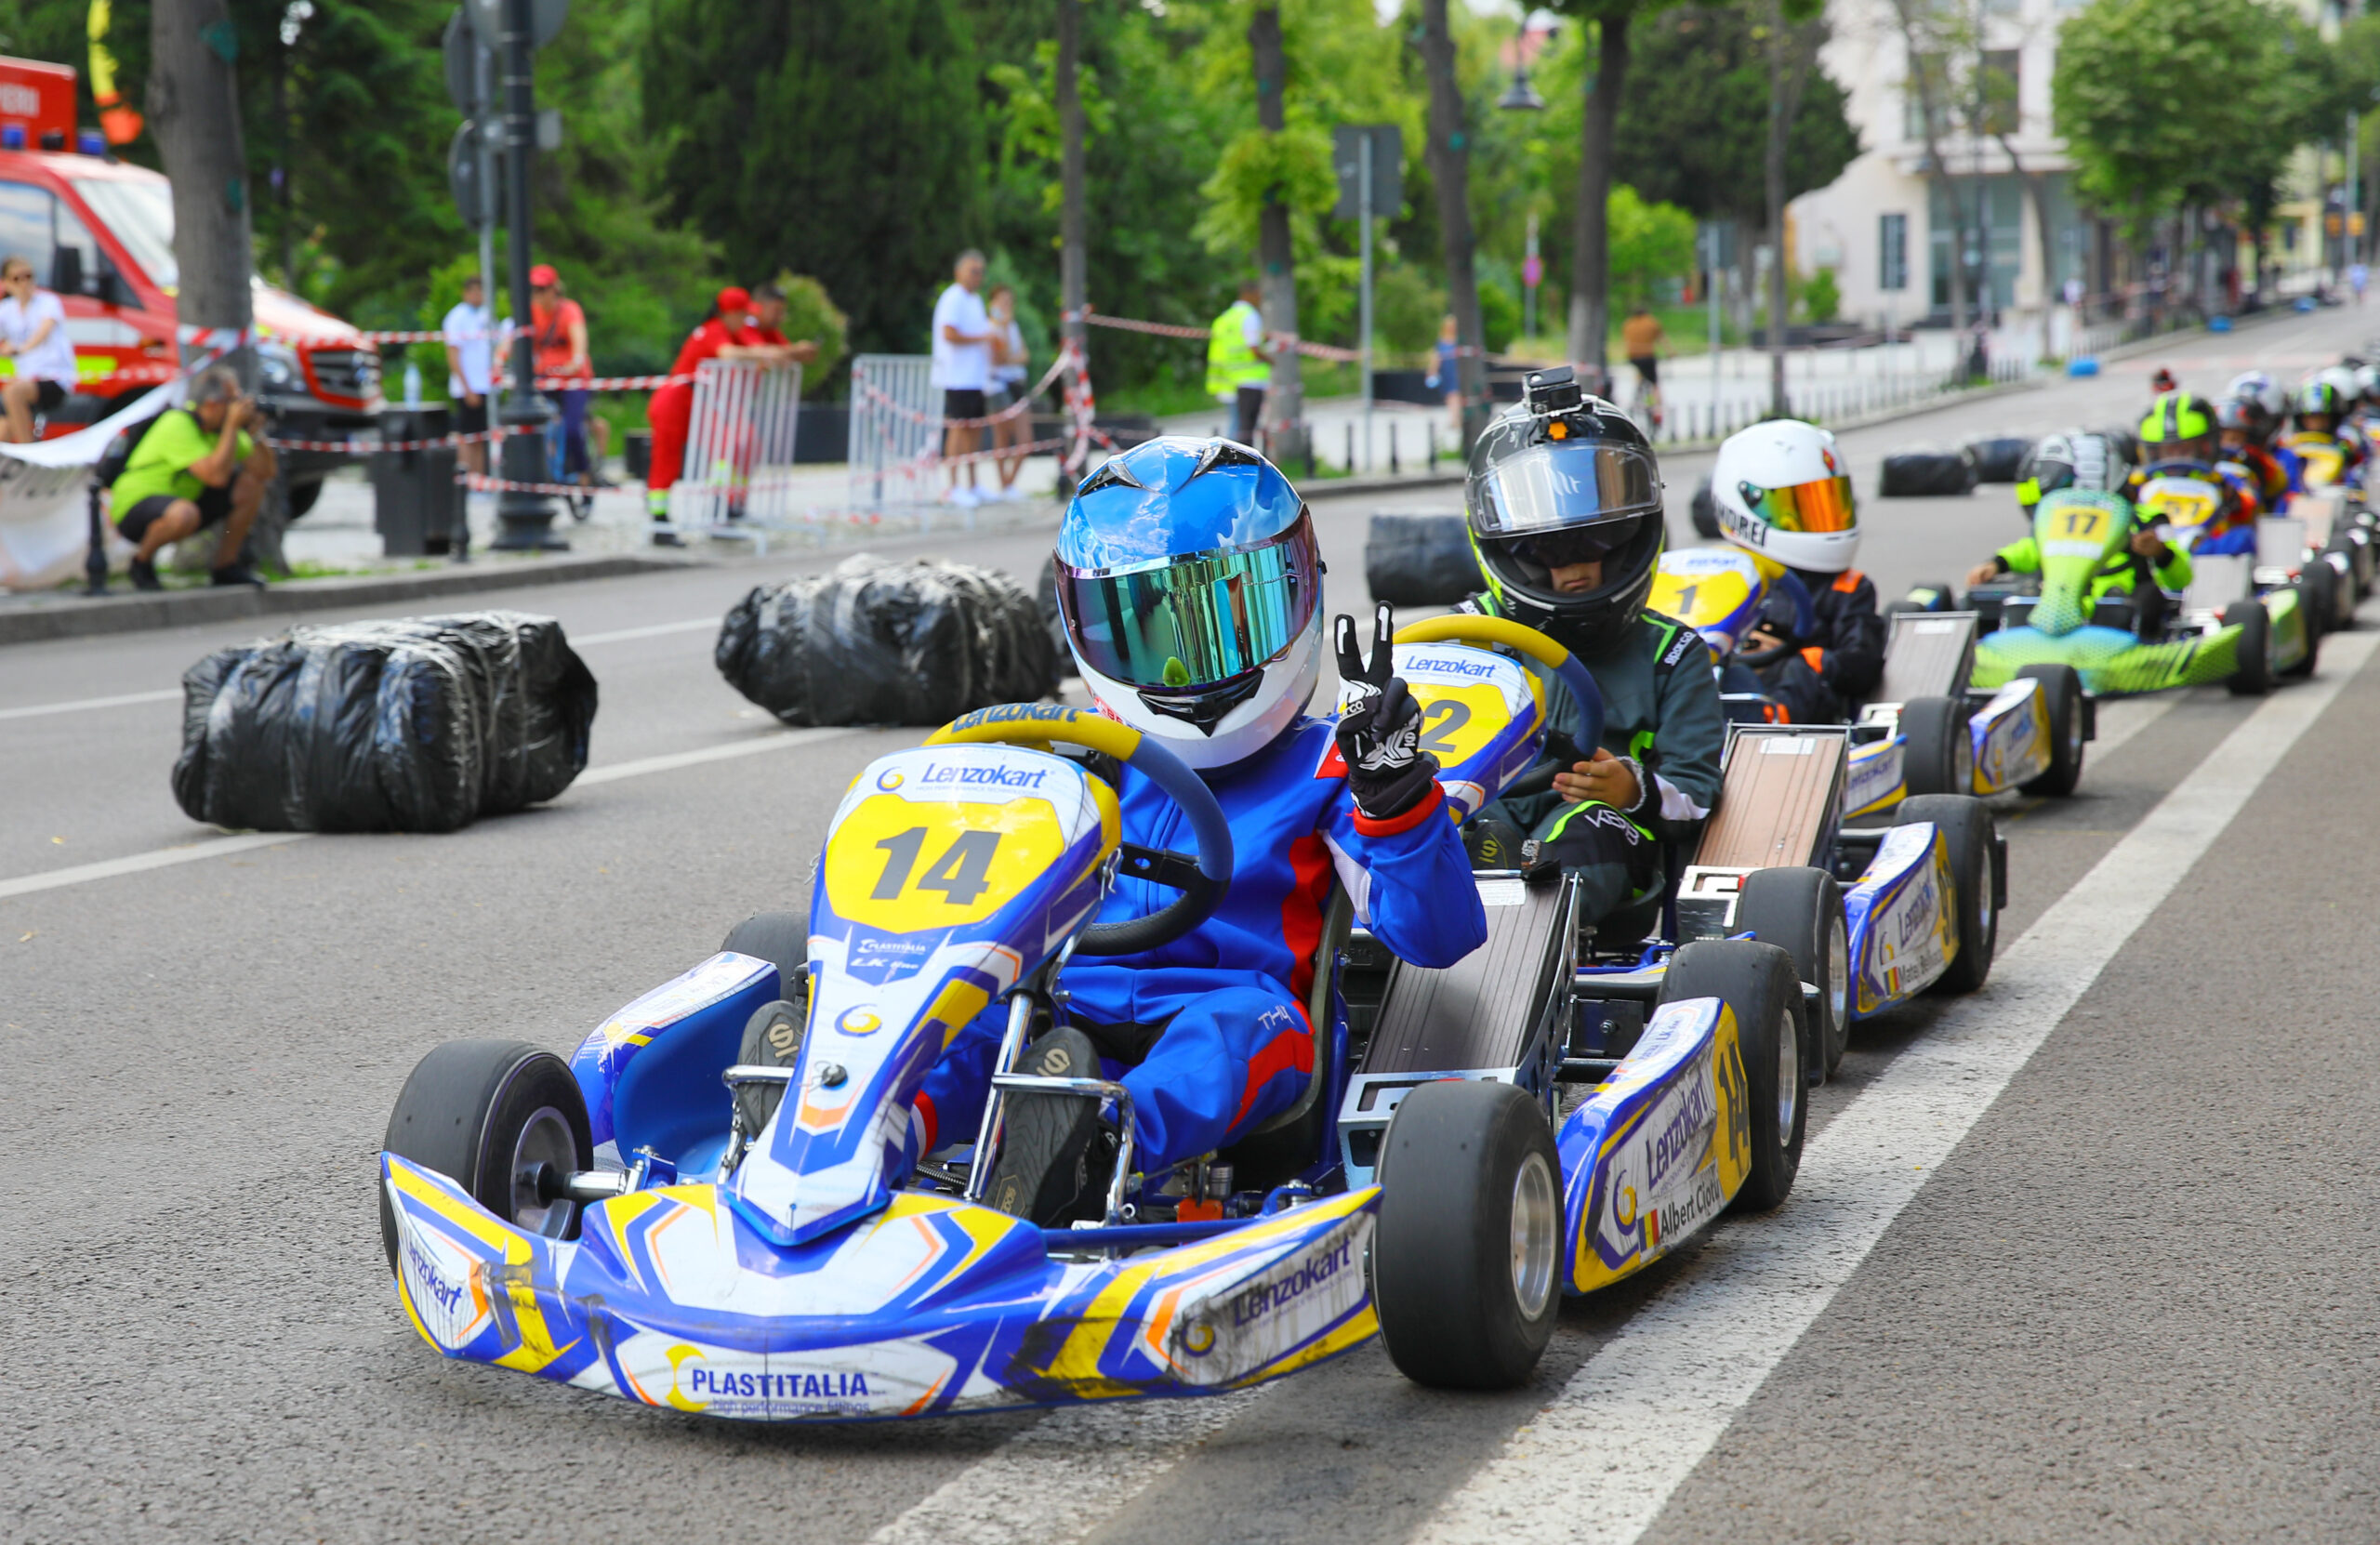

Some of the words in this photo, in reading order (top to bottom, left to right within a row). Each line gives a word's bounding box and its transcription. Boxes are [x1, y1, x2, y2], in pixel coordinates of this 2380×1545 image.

[2064, 513, 2098, 535] 17
[1675, 585, 1699, 615] 1
[1663, 630, 1699, 667] sparco
[1405, 655, 1498, 679] Lenzokart
[950, 702, 1079, 733] Lenzokart
[920, 762, 1048, 789] Lenzokart
[869, 826, 1003, 906] 14
[850, 957, 889, 967] LK
[1717, 1041, 1749, 1162] 14
[1646, 1067, 1708, 1192] Lenzokart
[1659, 1197, 1695, 1239] Albert
[403, 1227, 463, 1315] Lenzokart
[1235, 1236, 1351, 1327] Lenzokart
[693, 1368, 869, 1398] PLASTITALIA
[712, 1397, 739, 1417] high
[740, 1399, 824, 1418] performance
[826, 1401, 871, 1419] fittings
